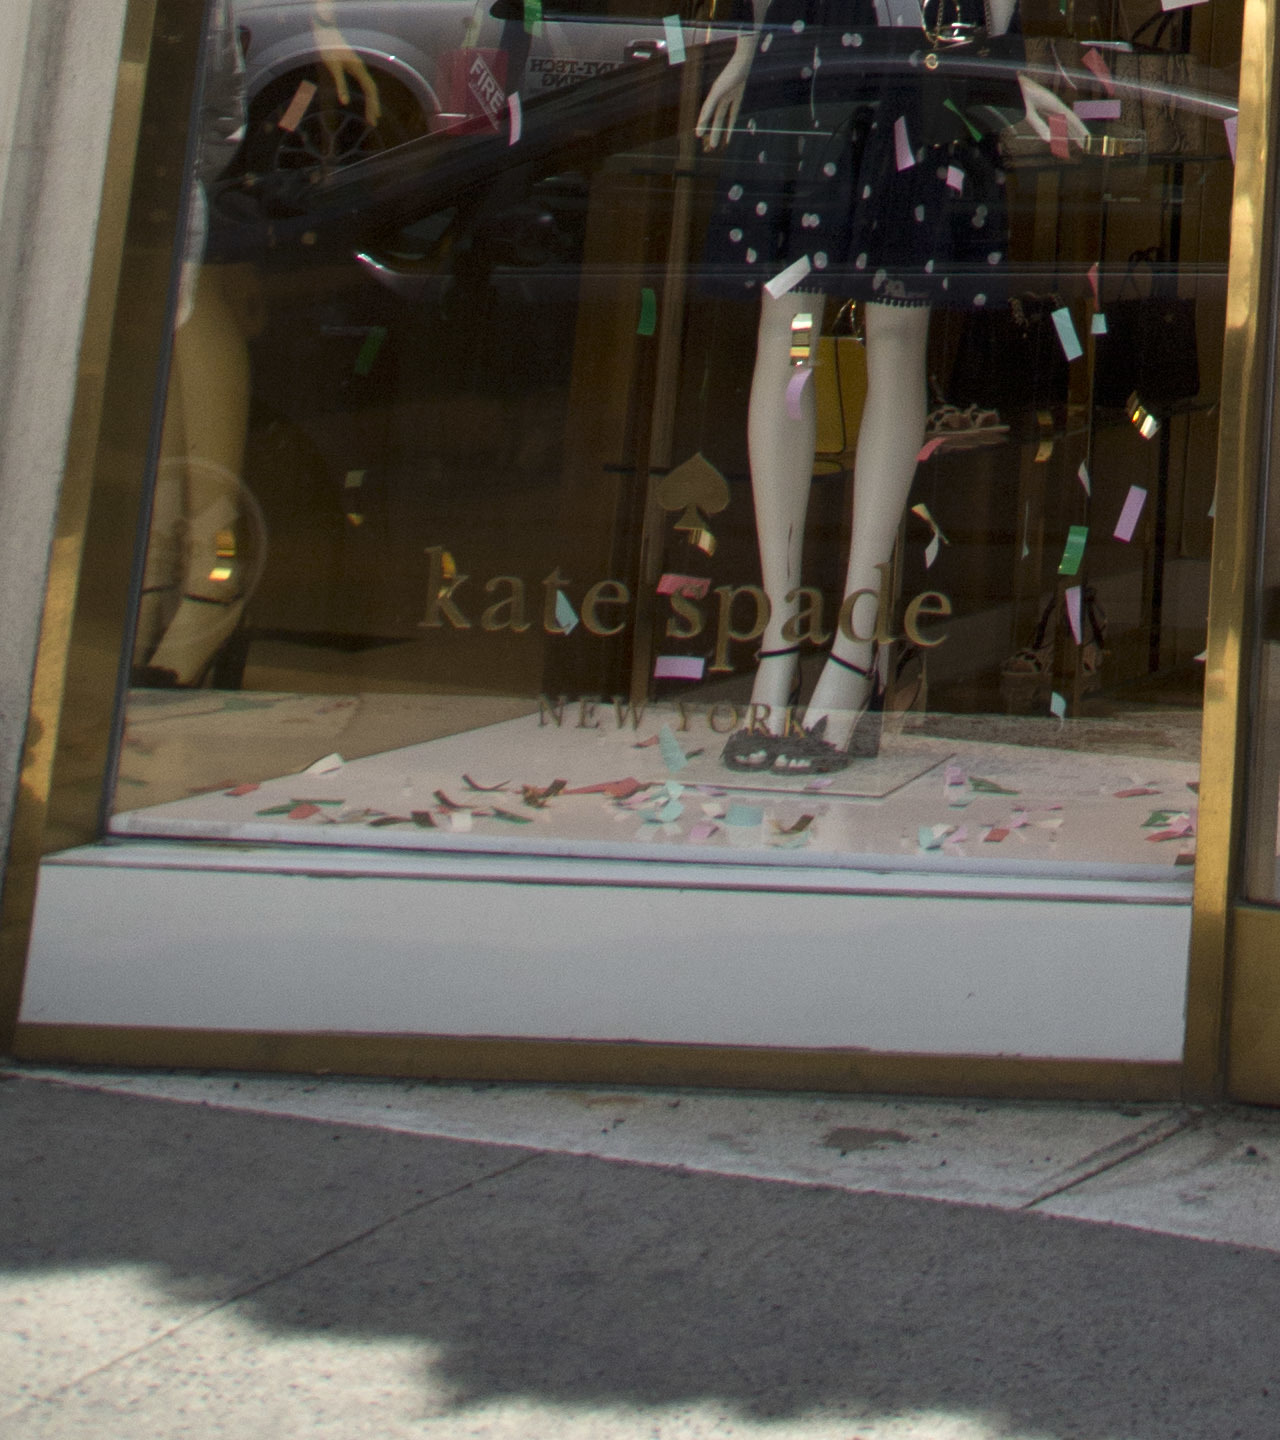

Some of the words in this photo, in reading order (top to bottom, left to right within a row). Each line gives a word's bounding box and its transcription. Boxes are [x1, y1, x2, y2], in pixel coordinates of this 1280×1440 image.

[469, 58, 505, 115] FIRE
[417, 545, 631, 637] kate
[664, 562, 953, 673] spade
[536, 693, 648, 731] NEW
[671, 700, 810, 739] YORK
